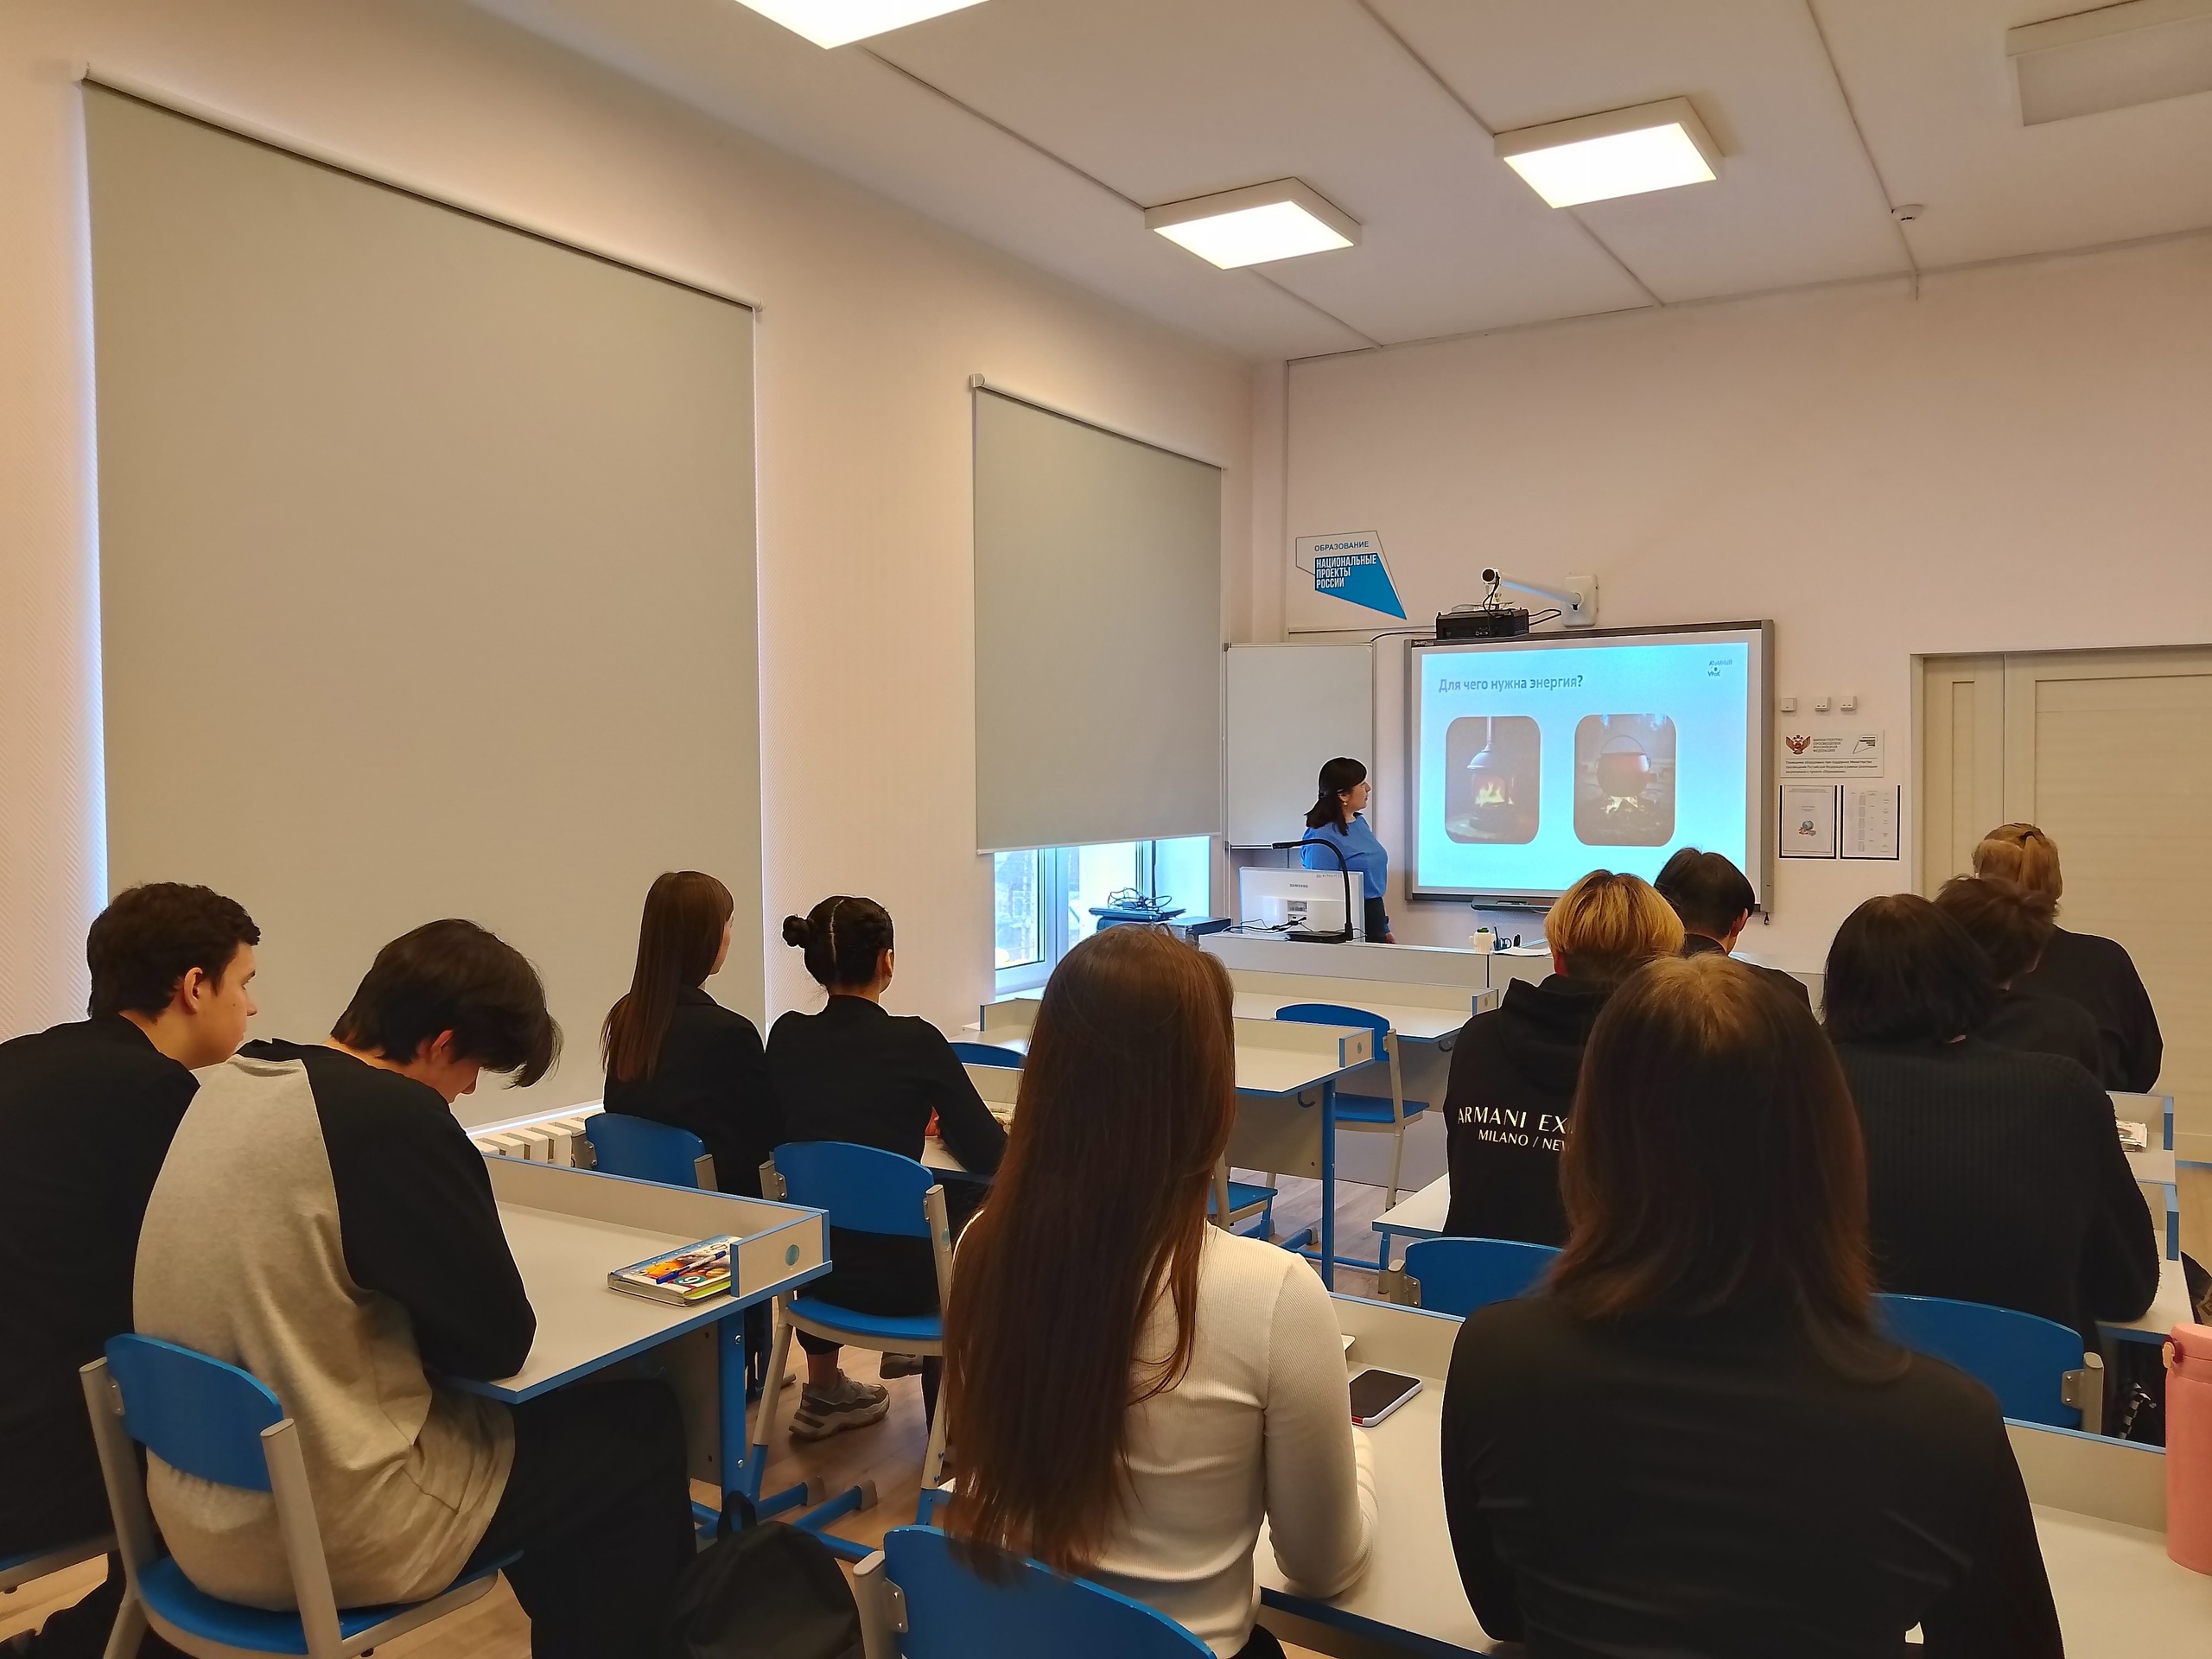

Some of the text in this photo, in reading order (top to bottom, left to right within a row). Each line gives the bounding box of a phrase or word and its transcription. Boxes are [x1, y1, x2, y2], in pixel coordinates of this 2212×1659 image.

[1314, 541, 1369, 551] ОБРАЗОВАНИЕ
[1316, 555, 1376, 569] НАЦИОНАЛЬНЫЕ
[1316, 567, 1351, 579] ПРОЕКТЫ
[1316, 577, 1344, 588] РОССИИ
[1439, 675, 1584, 693] Для чего нужна энергия?
[1458, 1106, 1573, 1135] ARMANI EX
[1478, 1128, 1529, 1147] MILANO
[1532, 1136, 1539, 1147] /
